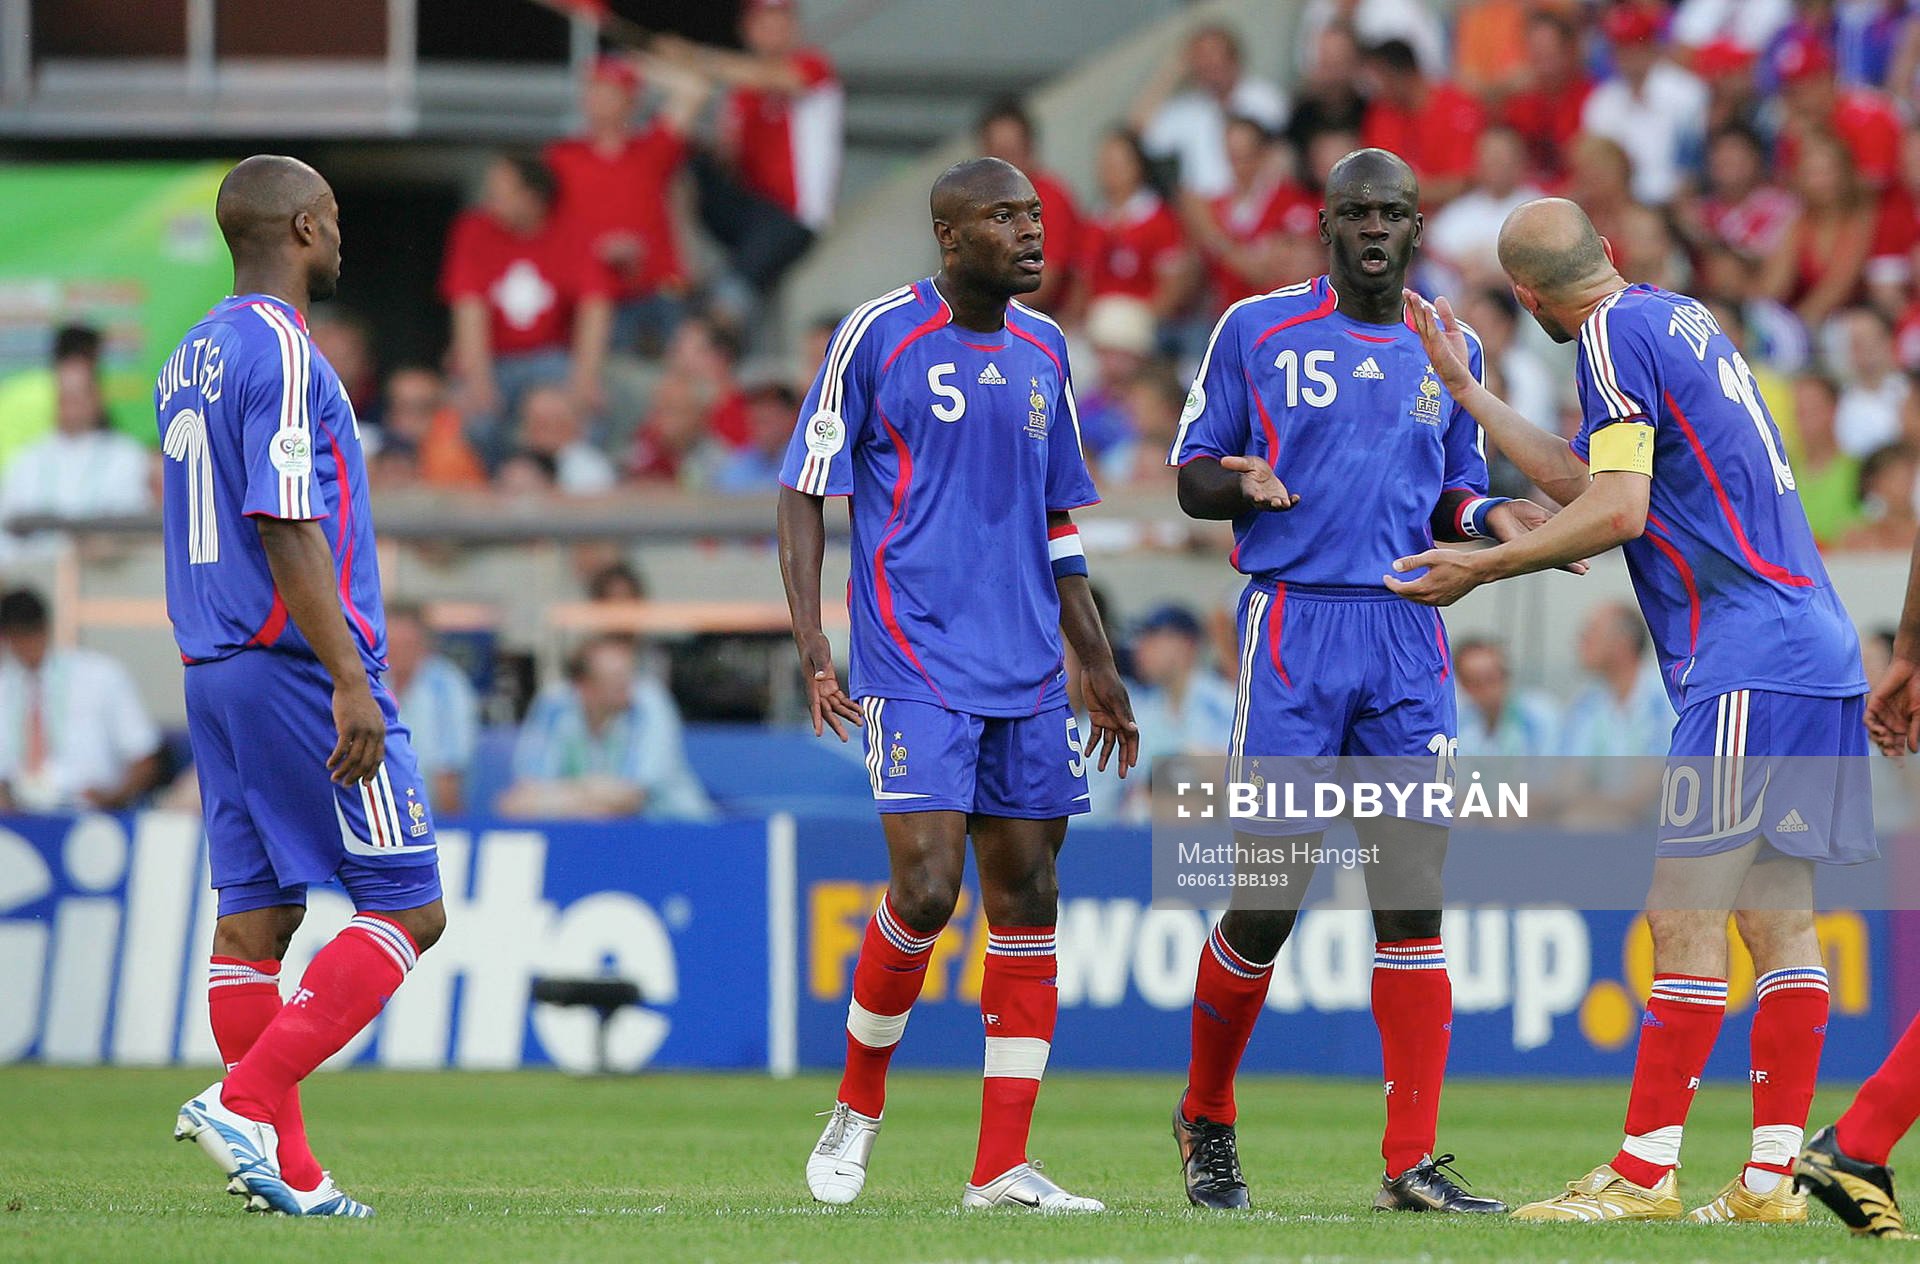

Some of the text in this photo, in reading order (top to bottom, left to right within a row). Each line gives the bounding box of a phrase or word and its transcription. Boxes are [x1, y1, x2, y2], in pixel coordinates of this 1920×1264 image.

[927, 362, 966, 423] 5
[977, 377, 1007, 385] adidas
[1274, 349, 1338, 408] 15
[1352, 371, 1385, 380] adidas
[1065, 717, 1086, 778] 5
[1660, 765, 1701, 827] 10
